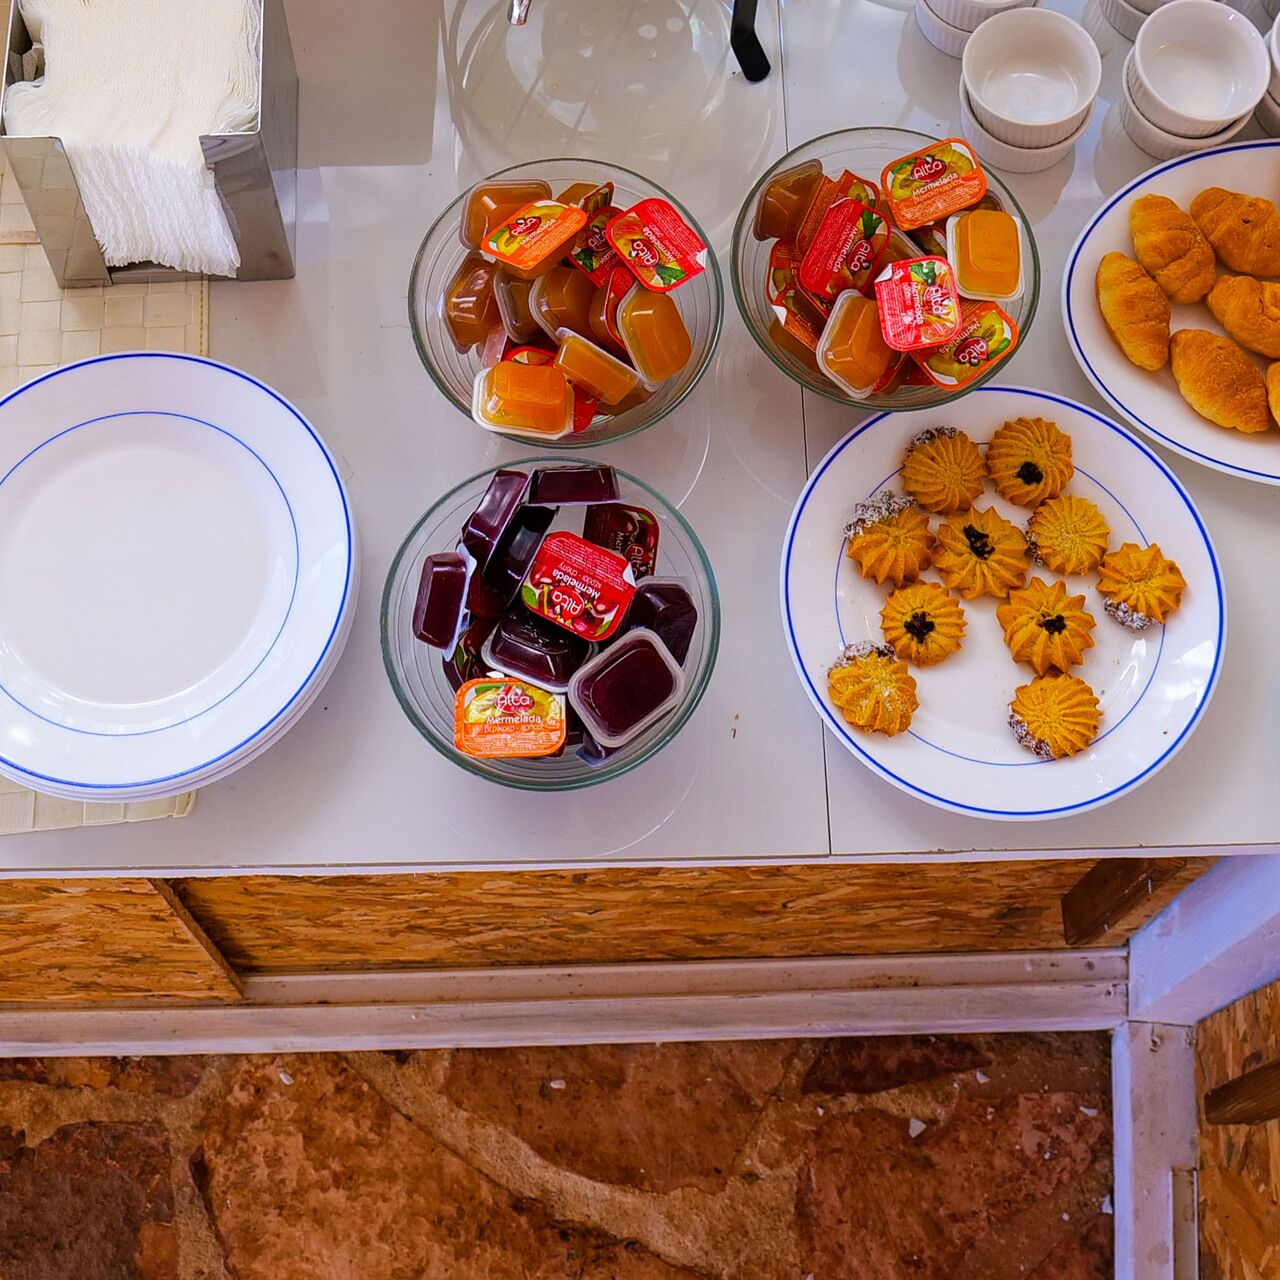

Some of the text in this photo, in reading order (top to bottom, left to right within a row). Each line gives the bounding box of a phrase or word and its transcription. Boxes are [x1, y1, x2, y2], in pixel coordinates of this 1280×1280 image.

[913, 160, 943, 179] Alta
[911, 171, 958, 196] Mermelada
[510, 217, 537, 236] Alta
[633, 240, 656, 266] Alta
[642, 226, 677, 262] Mermelada
[832, 225, 858, 273] Mermelada
[850, 242, 871, 272] Alta
[910, 281, 924, 325] Mermelada
[929, 286, 944, 314] Alta
[939, 319, 982, 354] Mermelada
[959, 340, 987, 363] Alta
[552, 568, 601, 600] Mermelada
[552, 590, 583, 615] Alta
[496, 693, 531, 706] Alta
[486, 714, 542, 724] Mermelada
